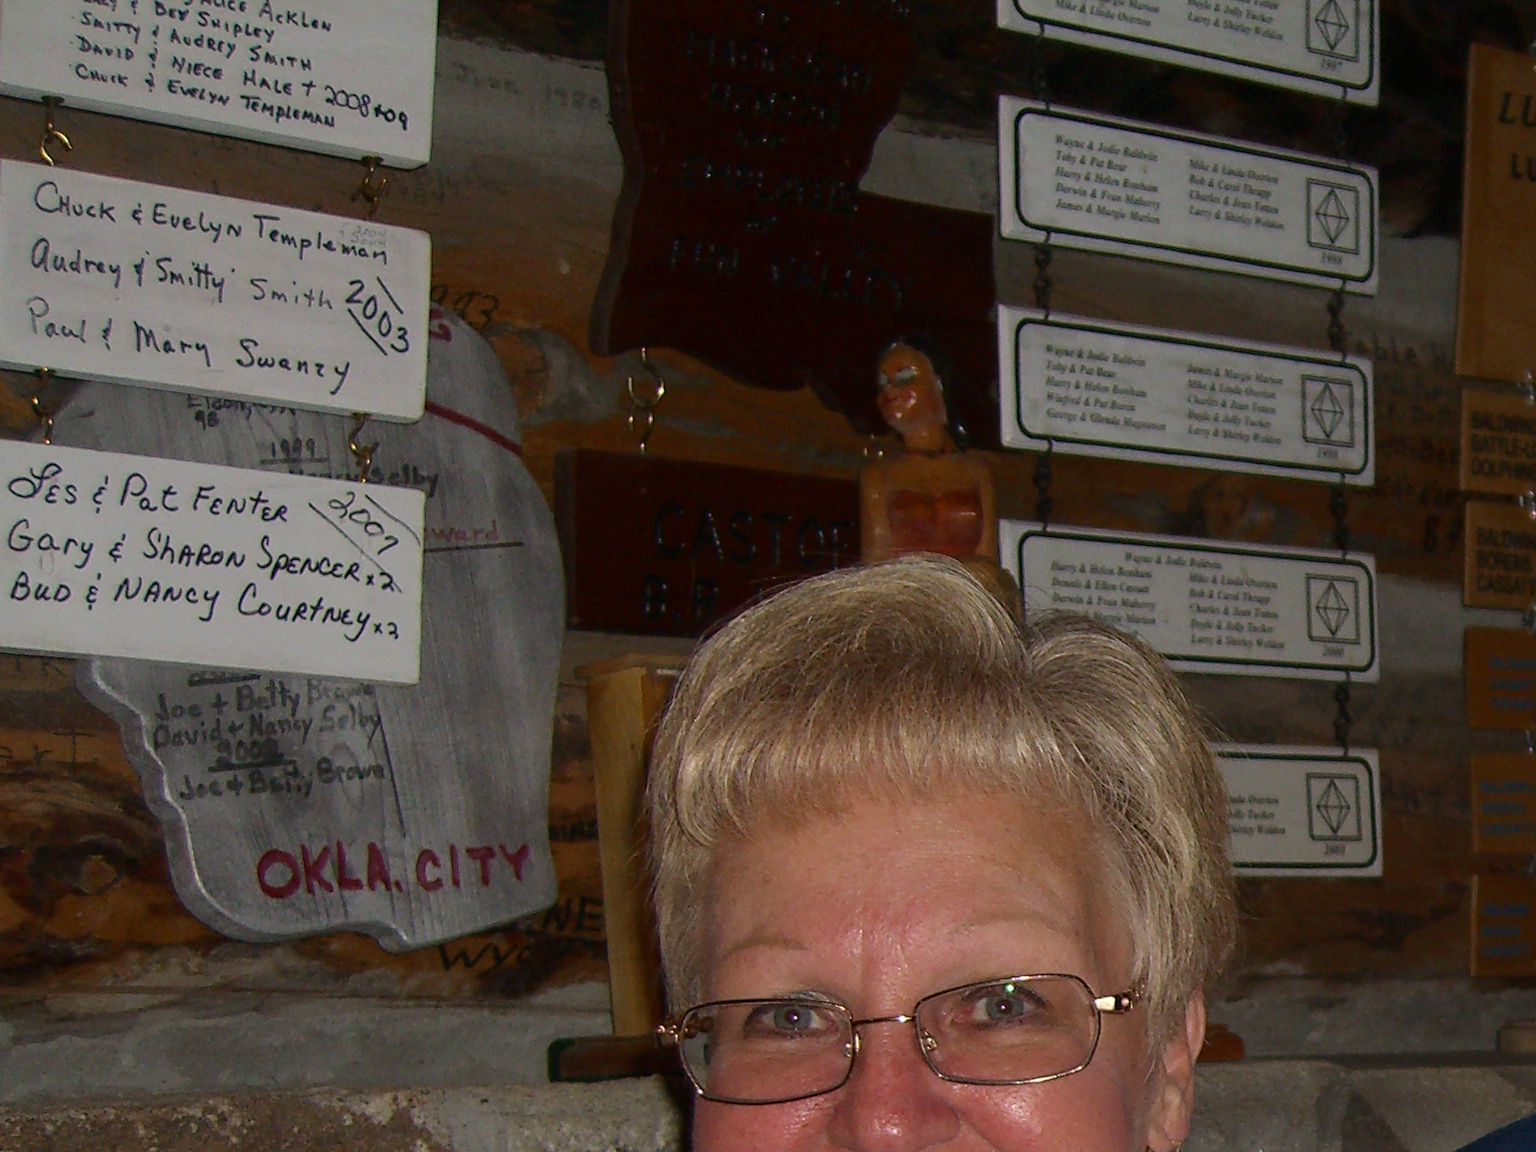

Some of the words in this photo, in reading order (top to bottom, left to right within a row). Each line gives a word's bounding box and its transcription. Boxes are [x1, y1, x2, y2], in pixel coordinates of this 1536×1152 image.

[75, 34, 135, 61] DAVID
[243, 70, 294, 97] HALE
[249, 45, 313, 72] SMITH
[252, 213, 388, 265] Templeman
[30, 239, 122, 289] Audrey
[250, 277, 334, 311] Smith
[345, 279, 410, 353] 2003
[670, 237, 739, 279] FUN
[769, 253, 914, 311] VALLEY
[27, 297, 86, 342] Paul
[133, 320, 211, 367] Mary
[120, 473, 179, 513] Pat
[7, 519, 94, 569] Gary
[109, 534, 126, 563] &
[256, 839, 404, 898] OKLA.
[416, 843, 530, 892] CITY
